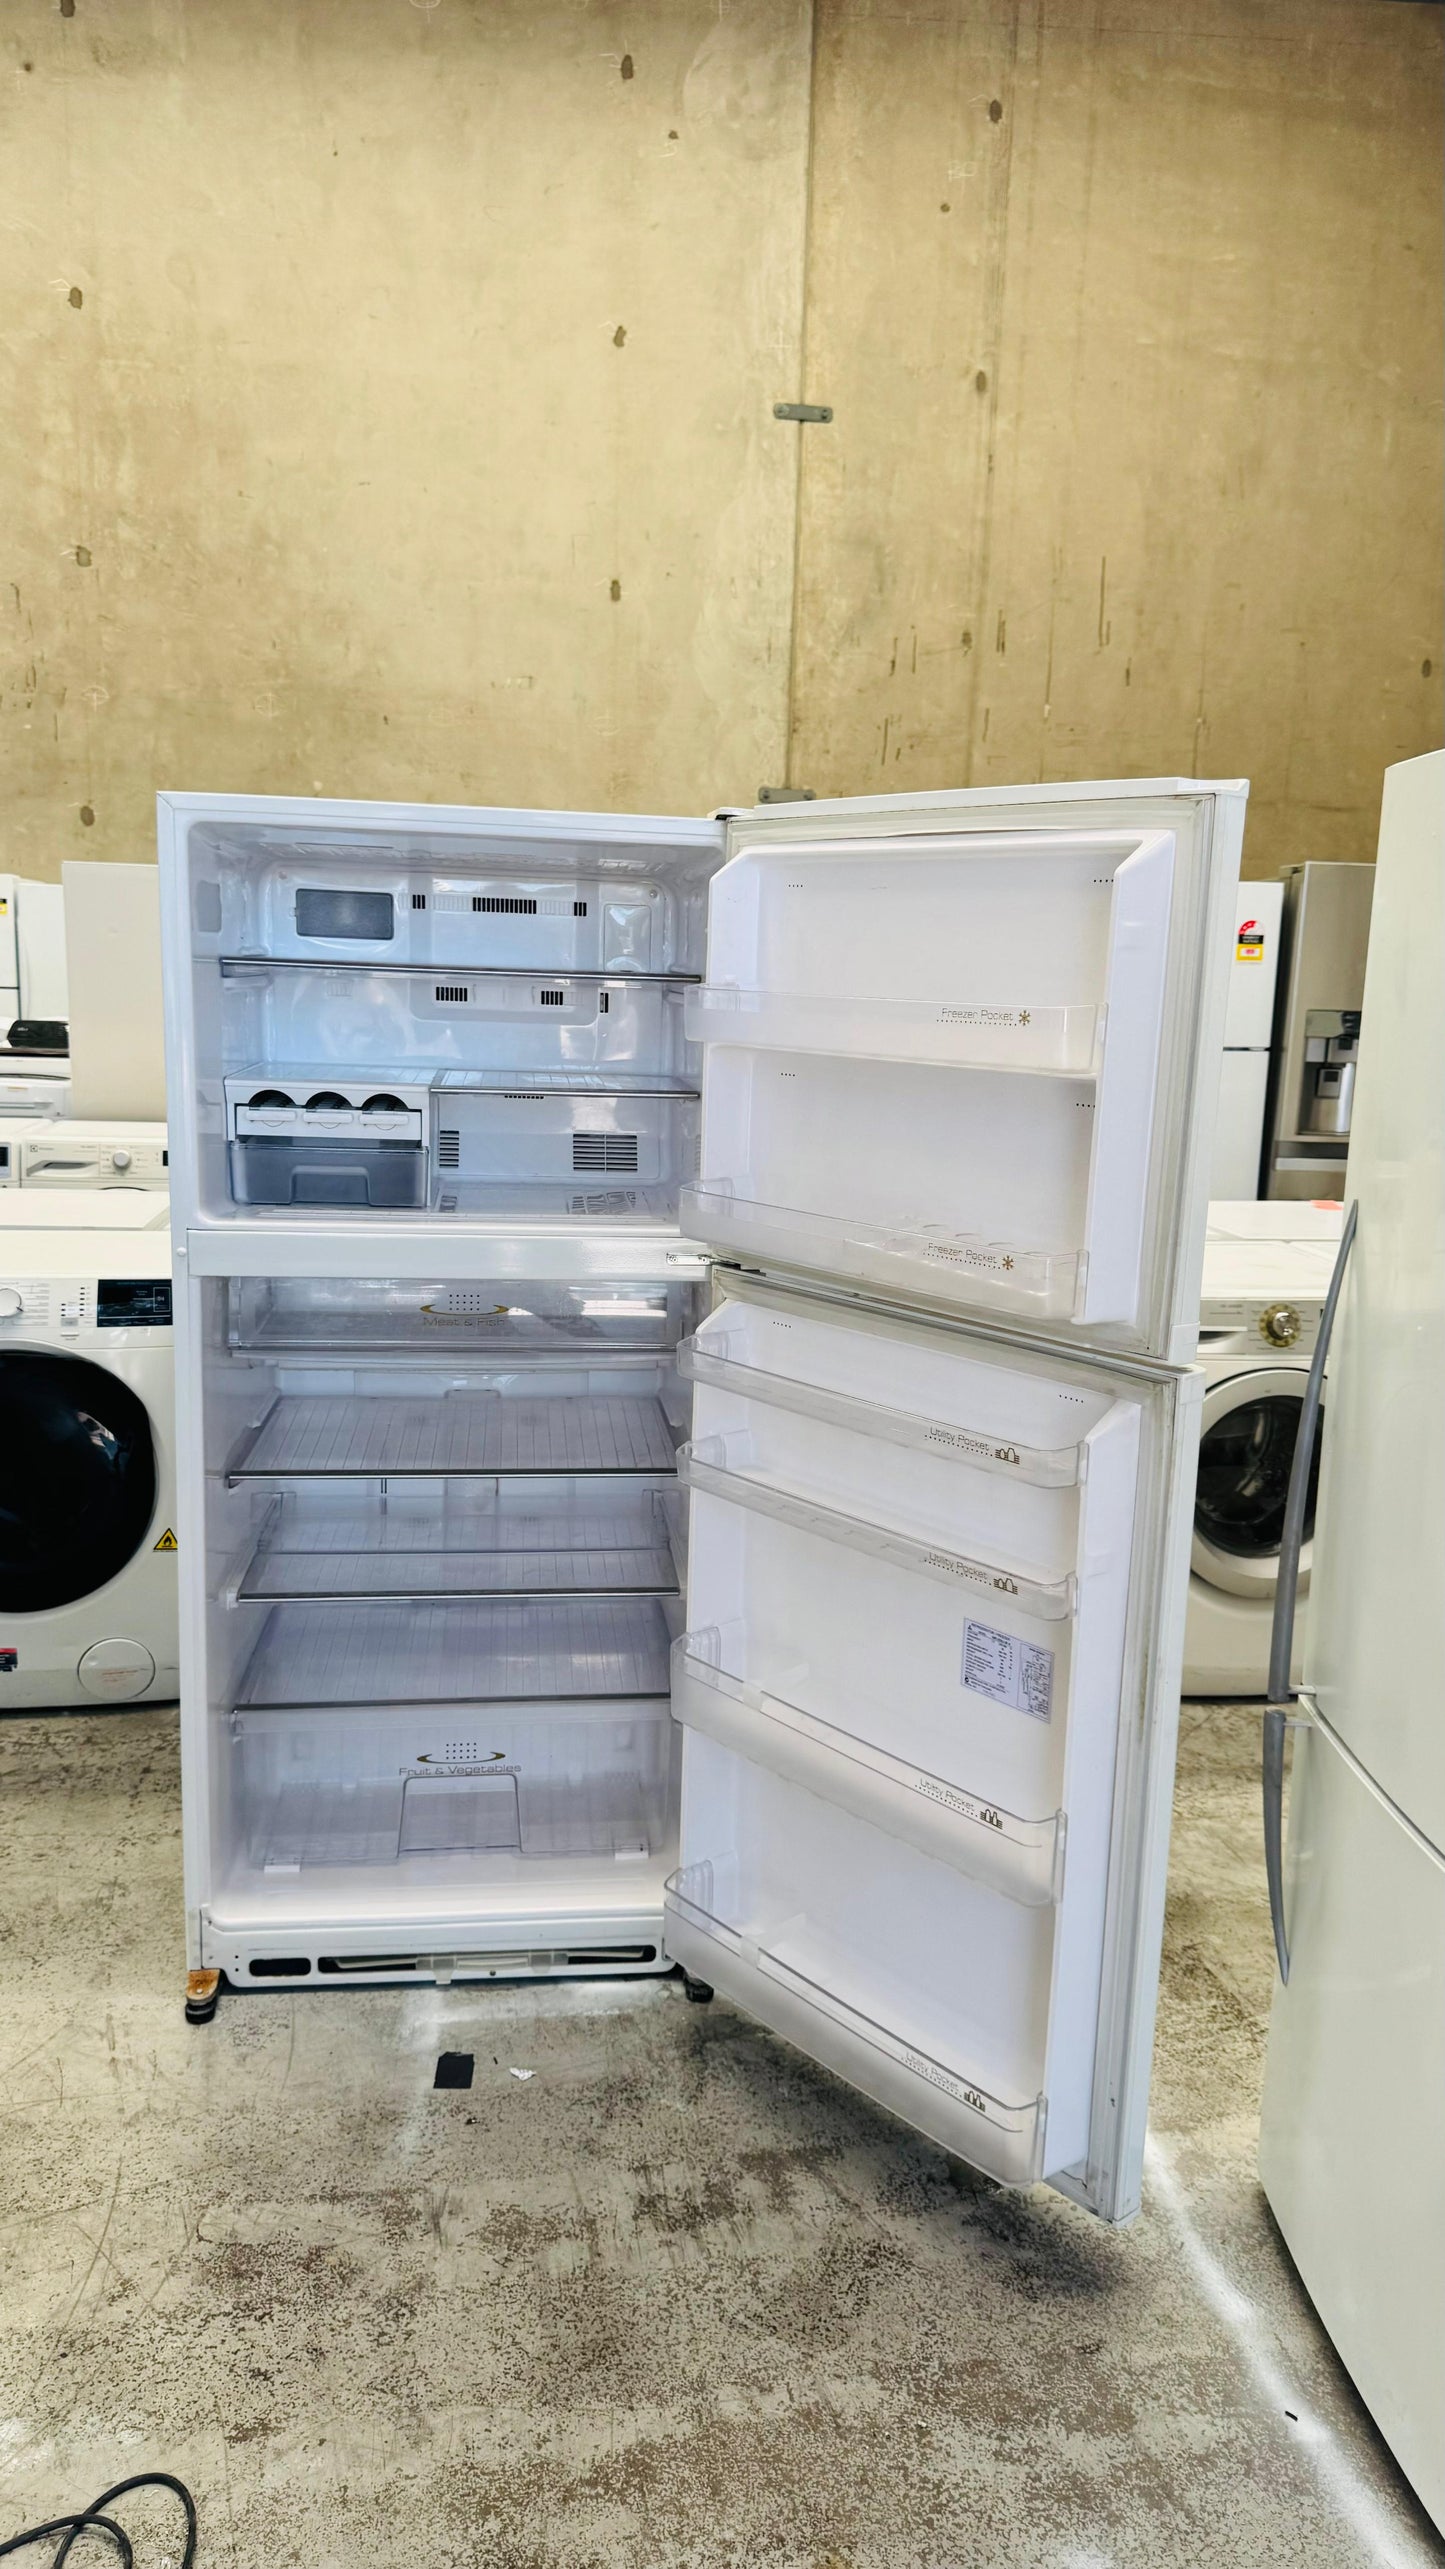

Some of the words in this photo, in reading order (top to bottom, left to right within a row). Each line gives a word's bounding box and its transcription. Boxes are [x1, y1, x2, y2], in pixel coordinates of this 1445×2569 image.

[941, 1007, 978, 1019] Freezer
[980, 1009, 1014, 1021] Pocket
[928, 1242, 963, 1256] Freezer
[966, 1249, 998, 1264] Pocket
[930, 1426, 956, 1442] Utility
[958, 1434, 990, 1451] Pocket
[929, 1552, 954, 1569] Utility
[956, 1561, 988, 1580] Pocket
[399, 1766, 432, 1776] Fruit
[435, 1767, 444, 1775] &
[448, 1764, 522, 1776] Vegetables
